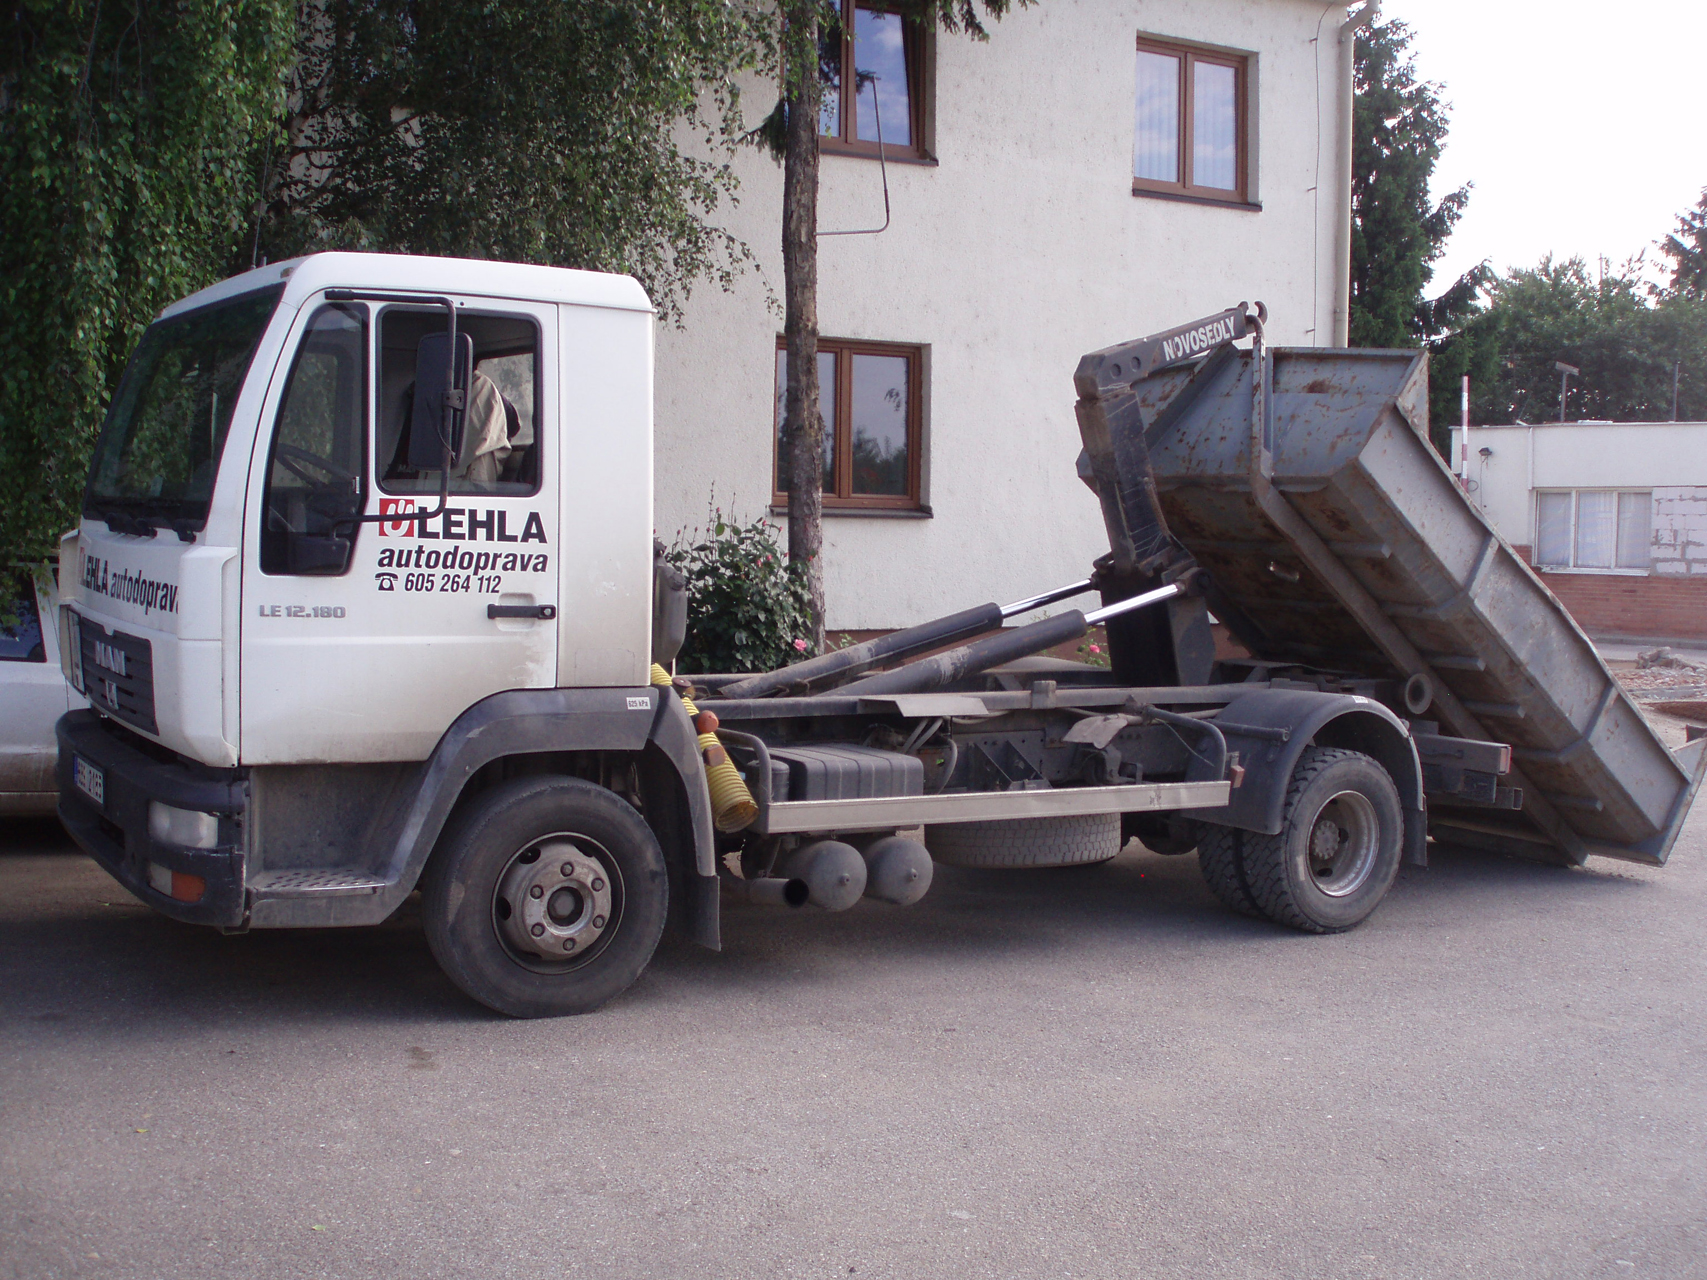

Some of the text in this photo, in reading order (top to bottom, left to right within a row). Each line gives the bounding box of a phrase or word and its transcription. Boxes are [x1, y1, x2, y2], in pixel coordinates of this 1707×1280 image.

[1163, 316, 1235, 361] NOVOSEDLY
[377, 545, 549, 575] autodoprava
[110, 568, 178, 615] autodoprav
[404, 573, 502, 593] 605 264 112
[259, 604, 346, 618] LE 12.180
[95, 641, 126, 676] MAN
